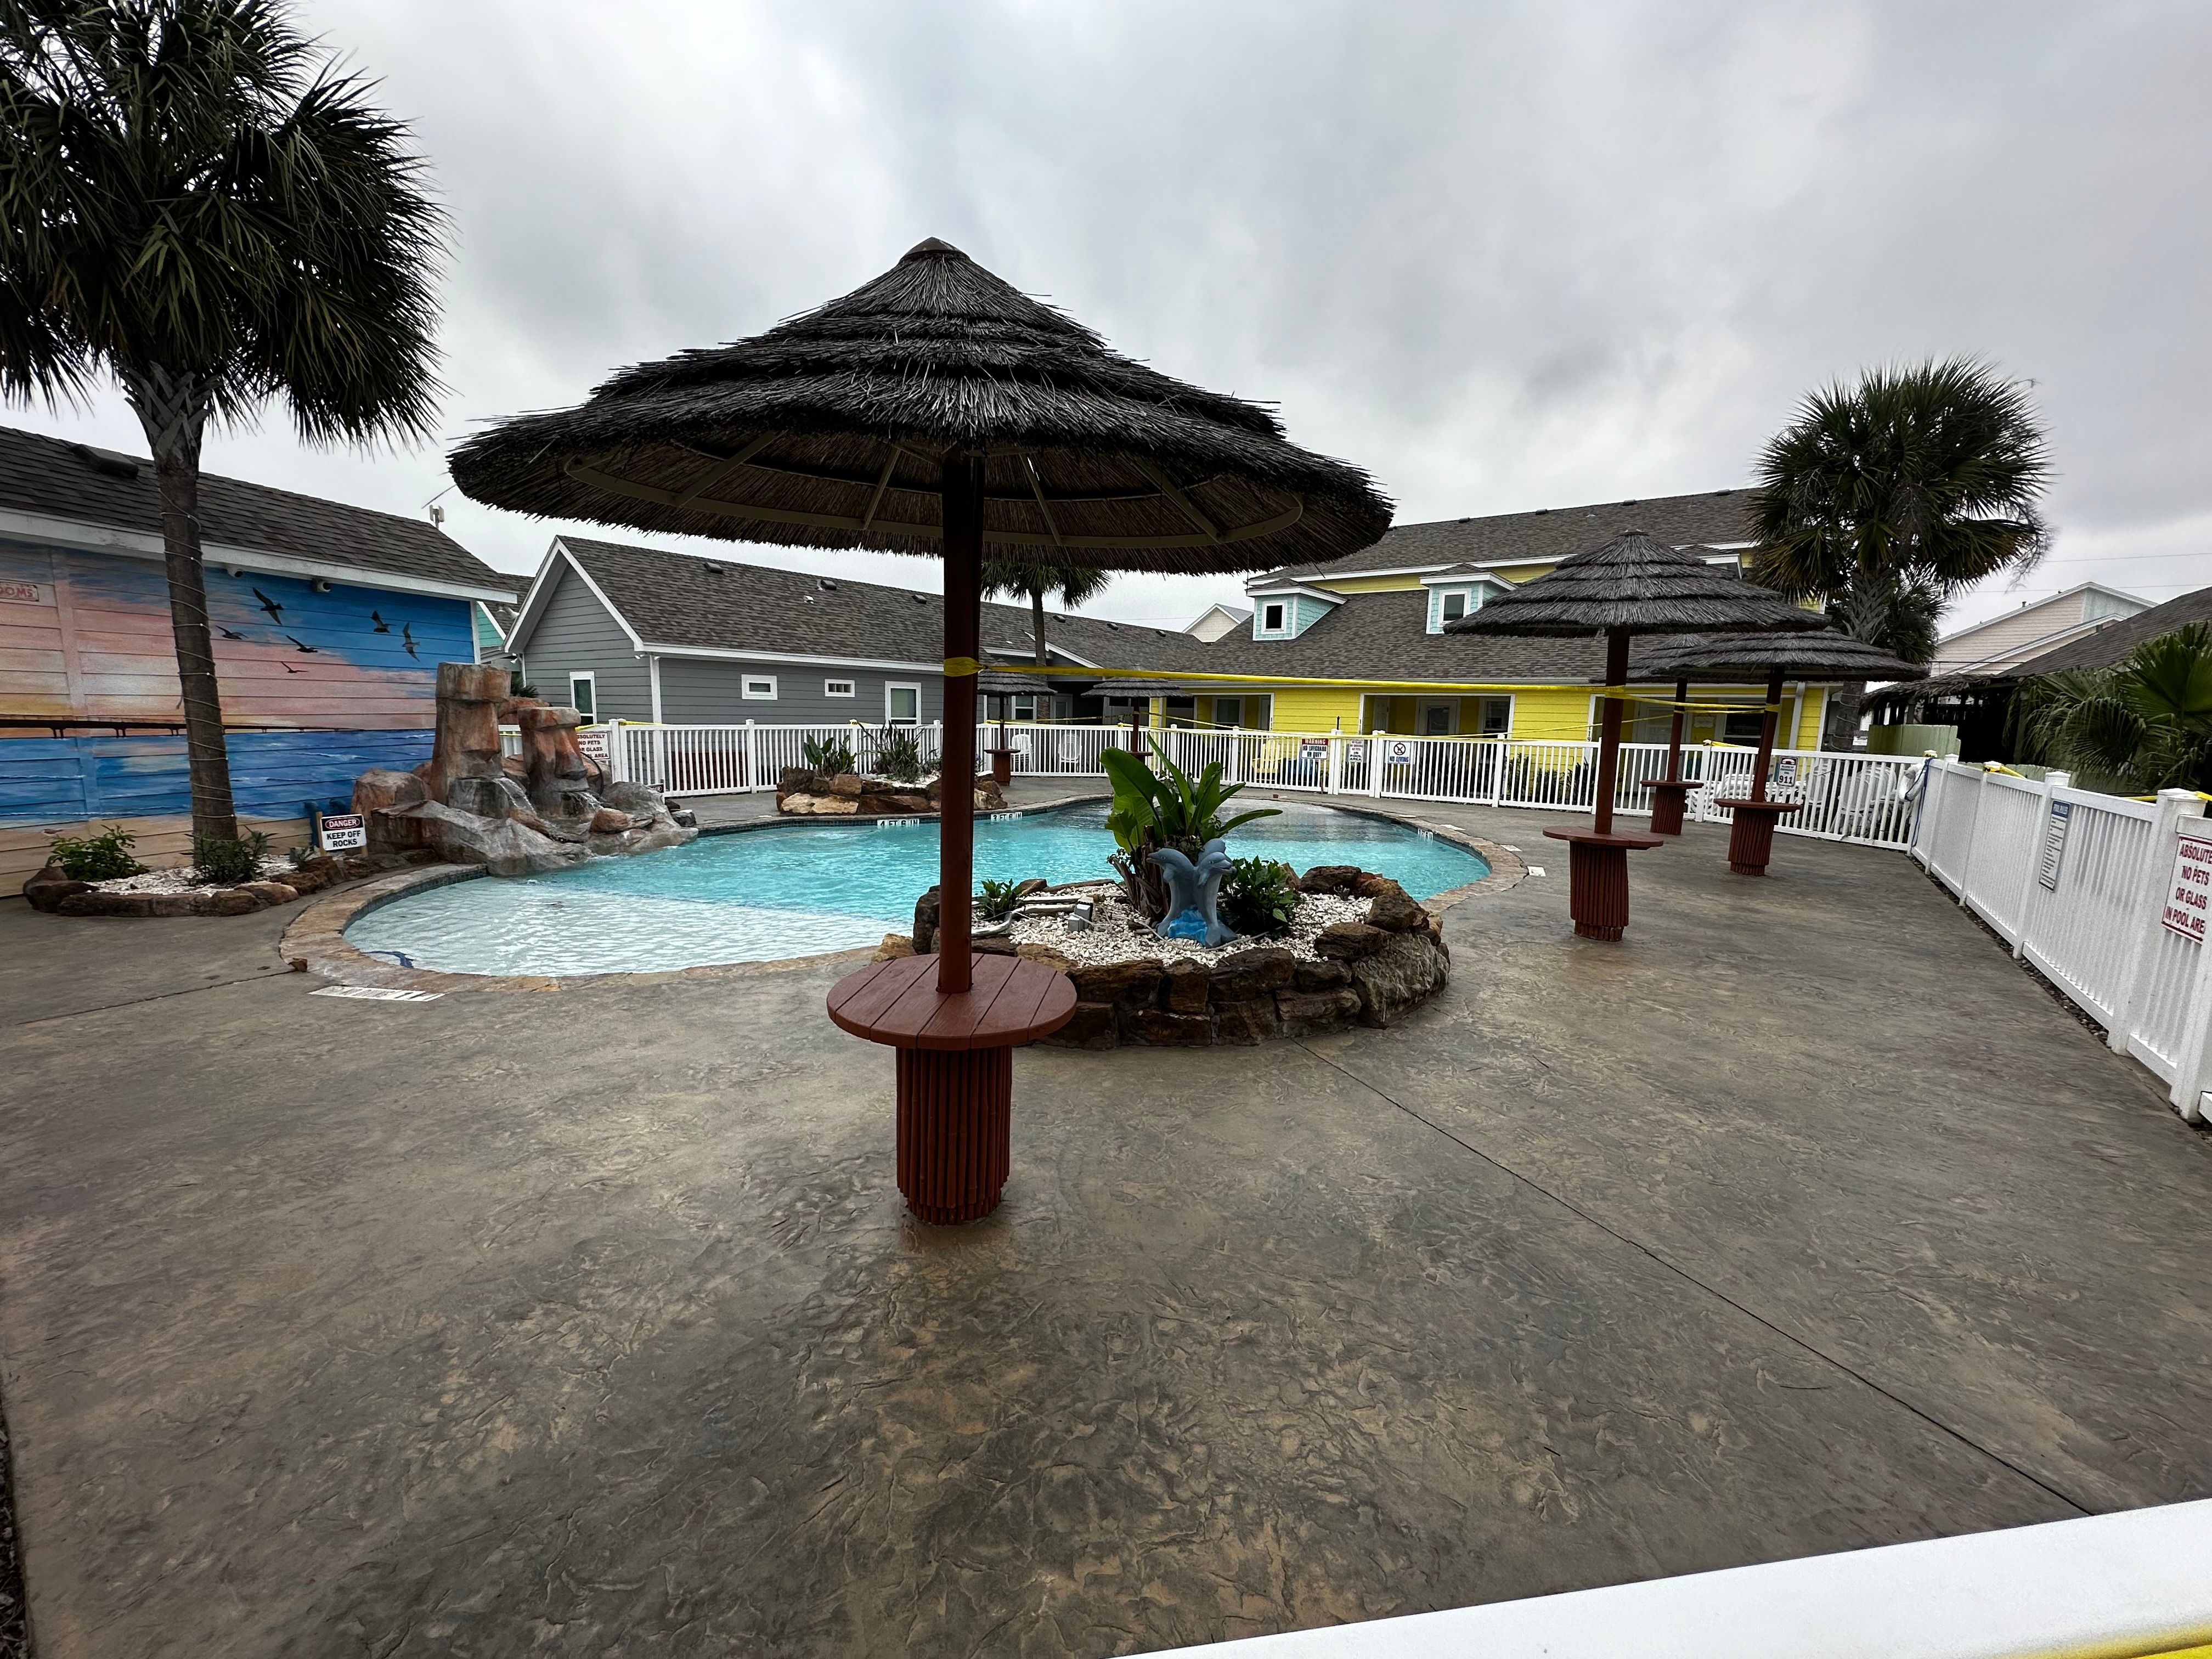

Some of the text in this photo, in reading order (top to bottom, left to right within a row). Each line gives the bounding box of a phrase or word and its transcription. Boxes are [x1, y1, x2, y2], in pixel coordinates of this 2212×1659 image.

[1779, 775, 1793, 784] 911
[329, 819, 357, 828] DANGER
[326, 832, 346, 840] KEEP
[332, 838, 358, 848] ROCKS
[2181, 865, 2210, 886] NO PETS
[2175, 887, 2208, 910] OR GLASS
[2165, 905, 2206, 934] IN POOL ARE
